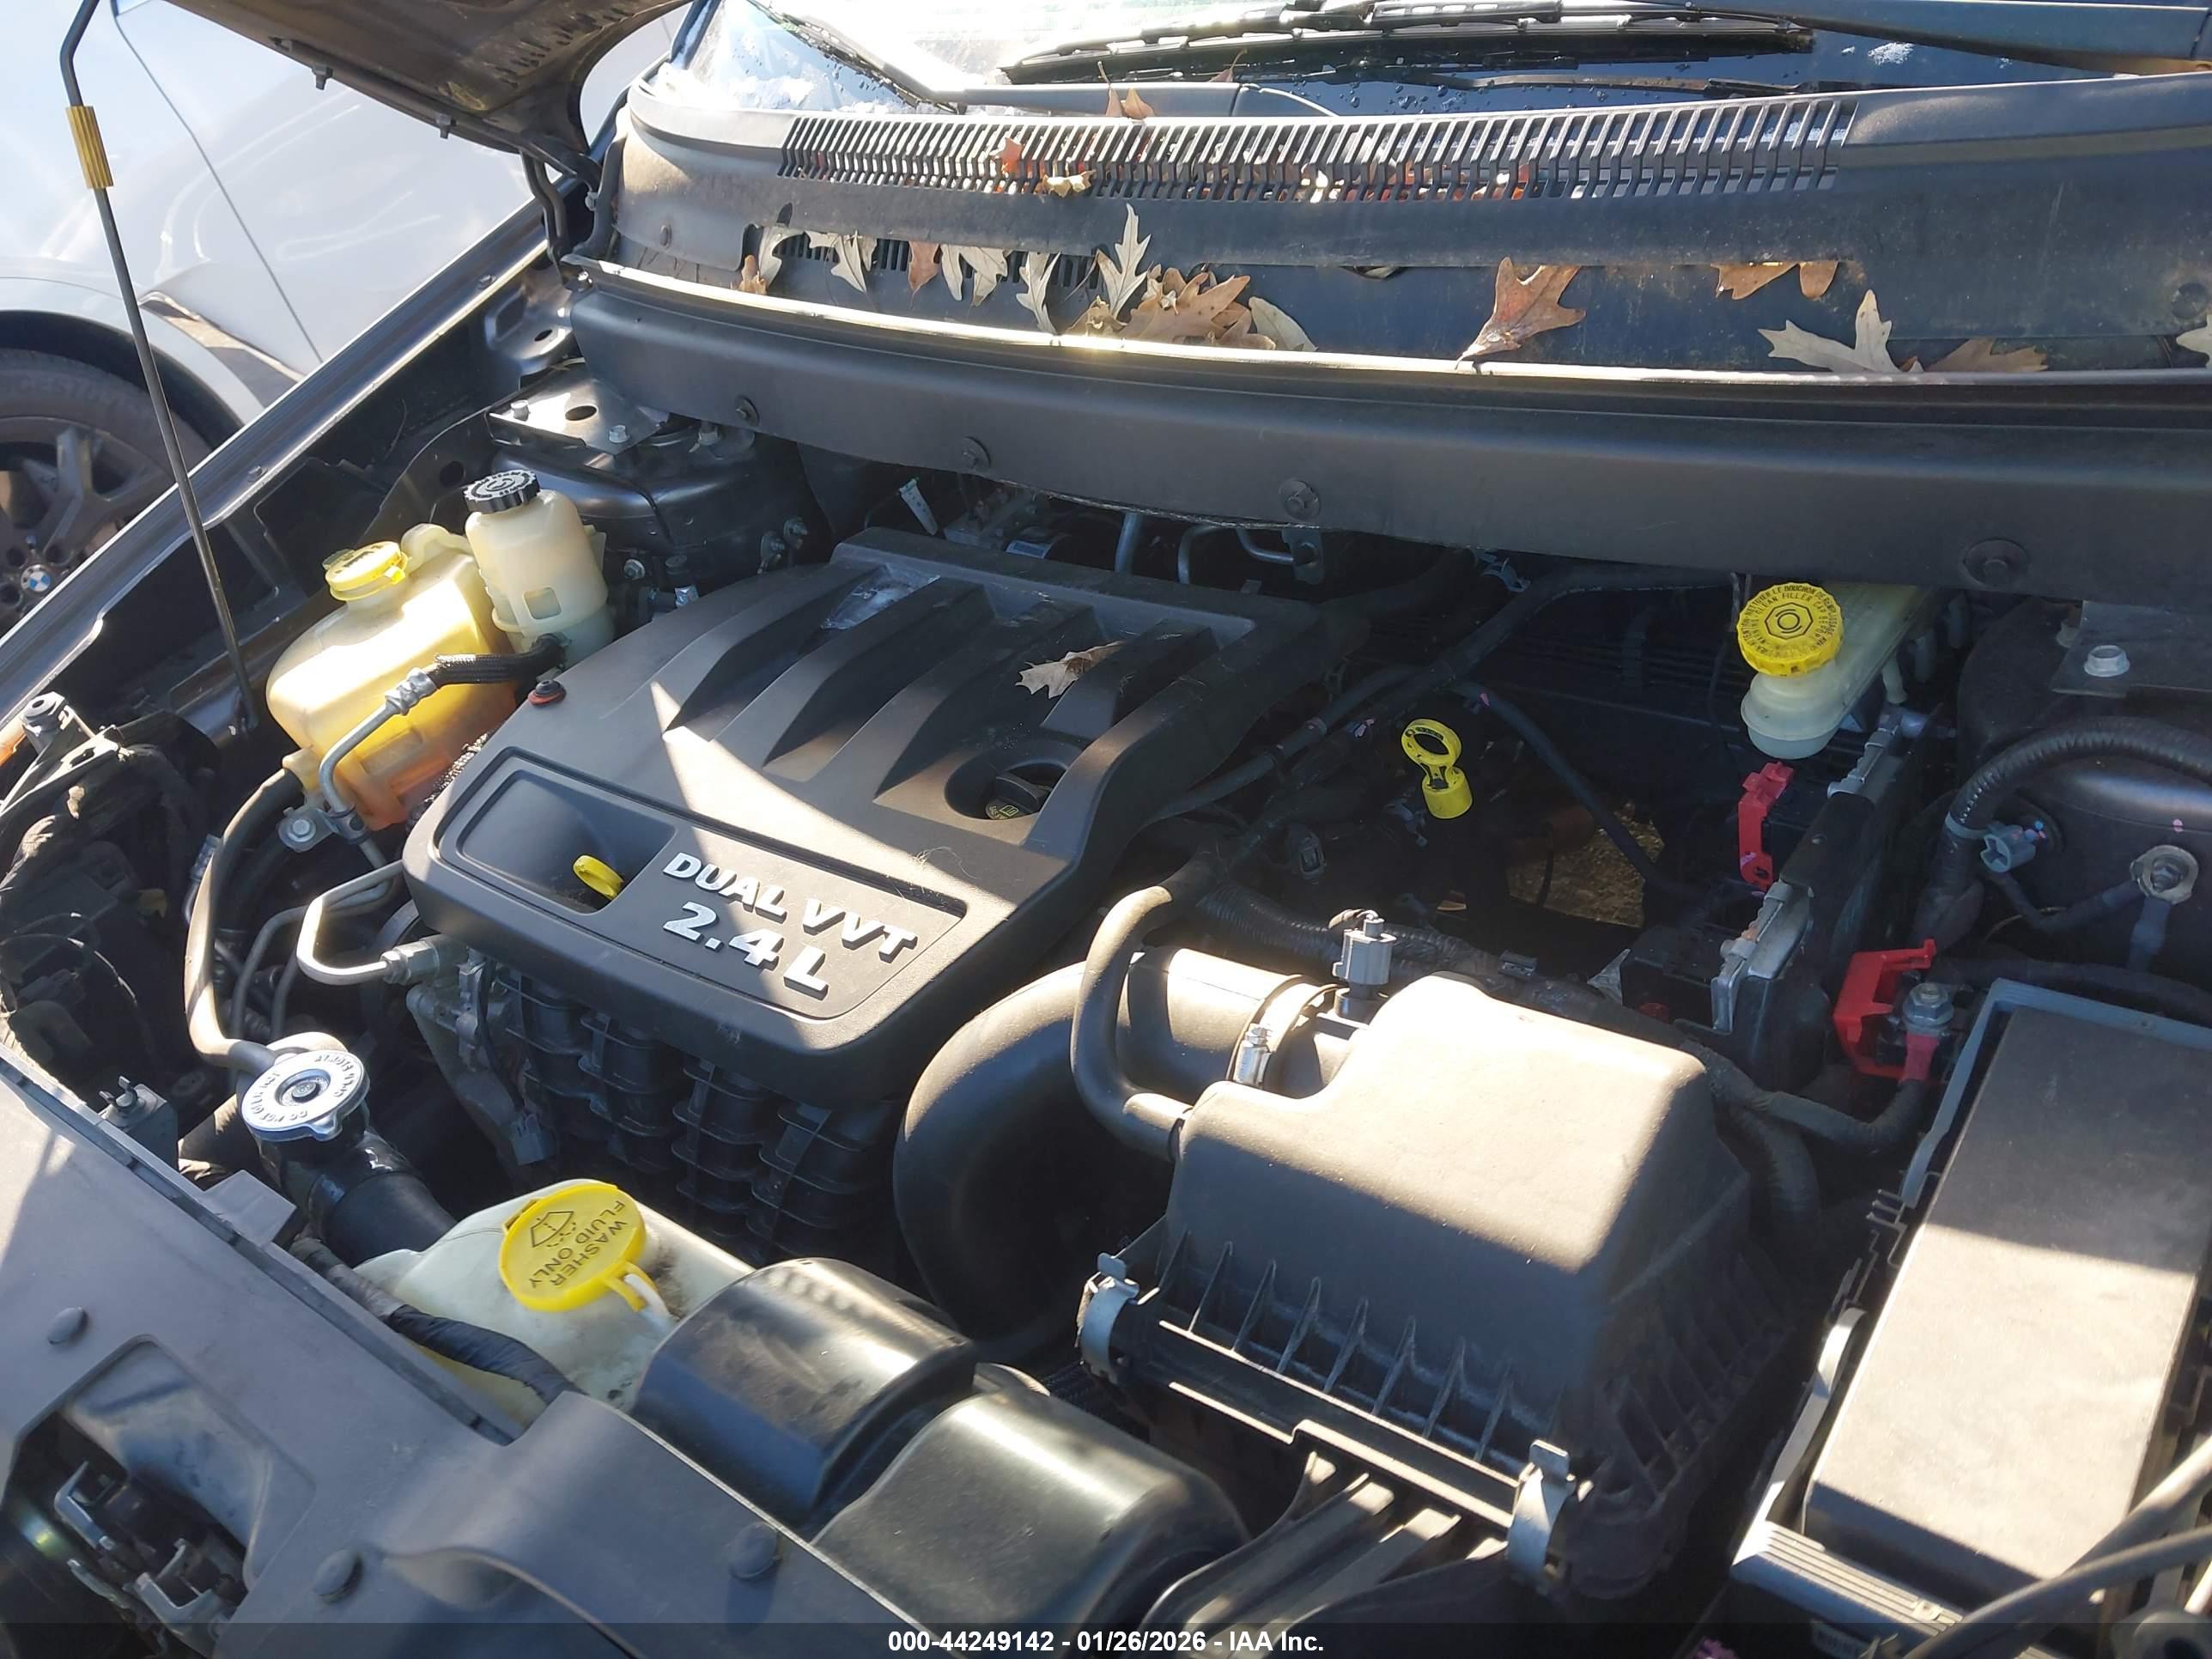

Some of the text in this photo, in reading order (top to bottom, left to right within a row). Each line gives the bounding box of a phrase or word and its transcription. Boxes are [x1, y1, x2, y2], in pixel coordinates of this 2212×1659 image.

[1782, 592, 1813, 602] FILLER
[662, 852, 918, 963] DUAL VVT
[528, 1200, 626, 1288] FLUID ONLY
[550, 1219, 628, 1286] WASHER
